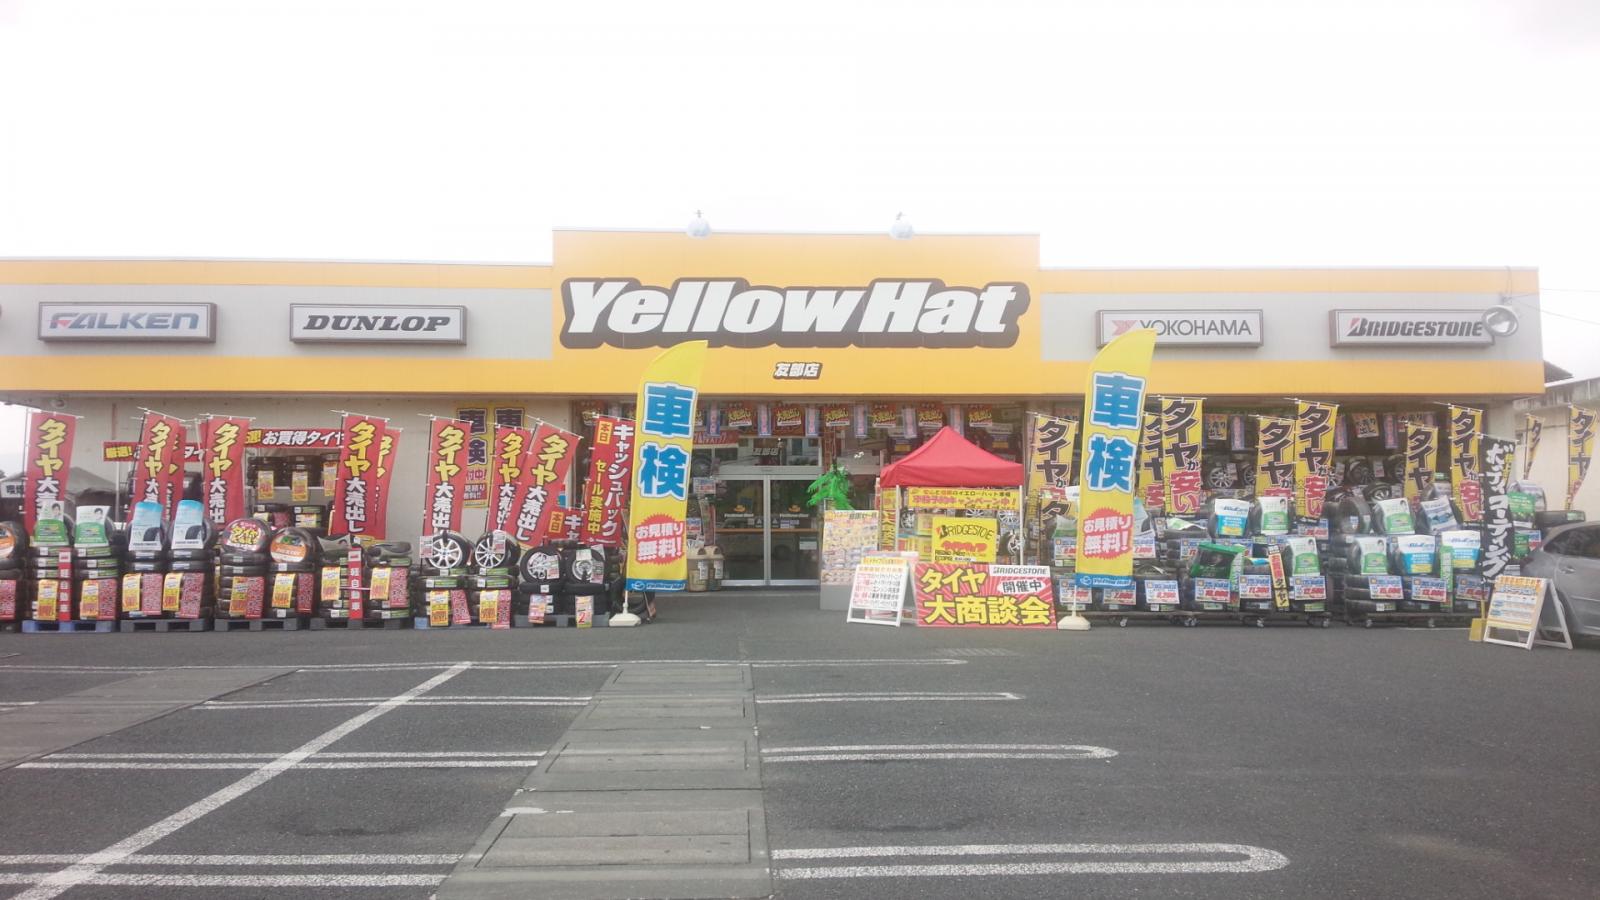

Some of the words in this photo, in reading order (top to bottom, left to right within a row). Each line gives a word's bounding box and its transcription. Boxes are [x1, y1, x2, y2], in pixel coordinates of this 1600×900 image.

[50, 311, 200, 331] FALKEN
[302, 313, 452, 333] DUNLOP
[1140, 319, 1253, 336] YOKOHAMA
[1347, 317, 1483, 337] BRIDGESTONE
[774, 362, 820, 379] 友部店
[597, 420, 612, 445] 本日
[638, 380, 696, 501] 車検
[1087, 374, 1143, 493] 車検
[35, 418, 67, 511] タイヤ大
[1163, 400, 1200, 513] タイヤが安い
[344, 421, 376, 534] タイヤ大売出し
[431, 425, 465, 533] タイヤ大売出
[602, 424, 634, 537] キャッシュバック
[920, 566, 988, 594] タイヤ
[1002, 580, 1042, 593] 開催中
[923, 594, 1050, 625] 大商談会
